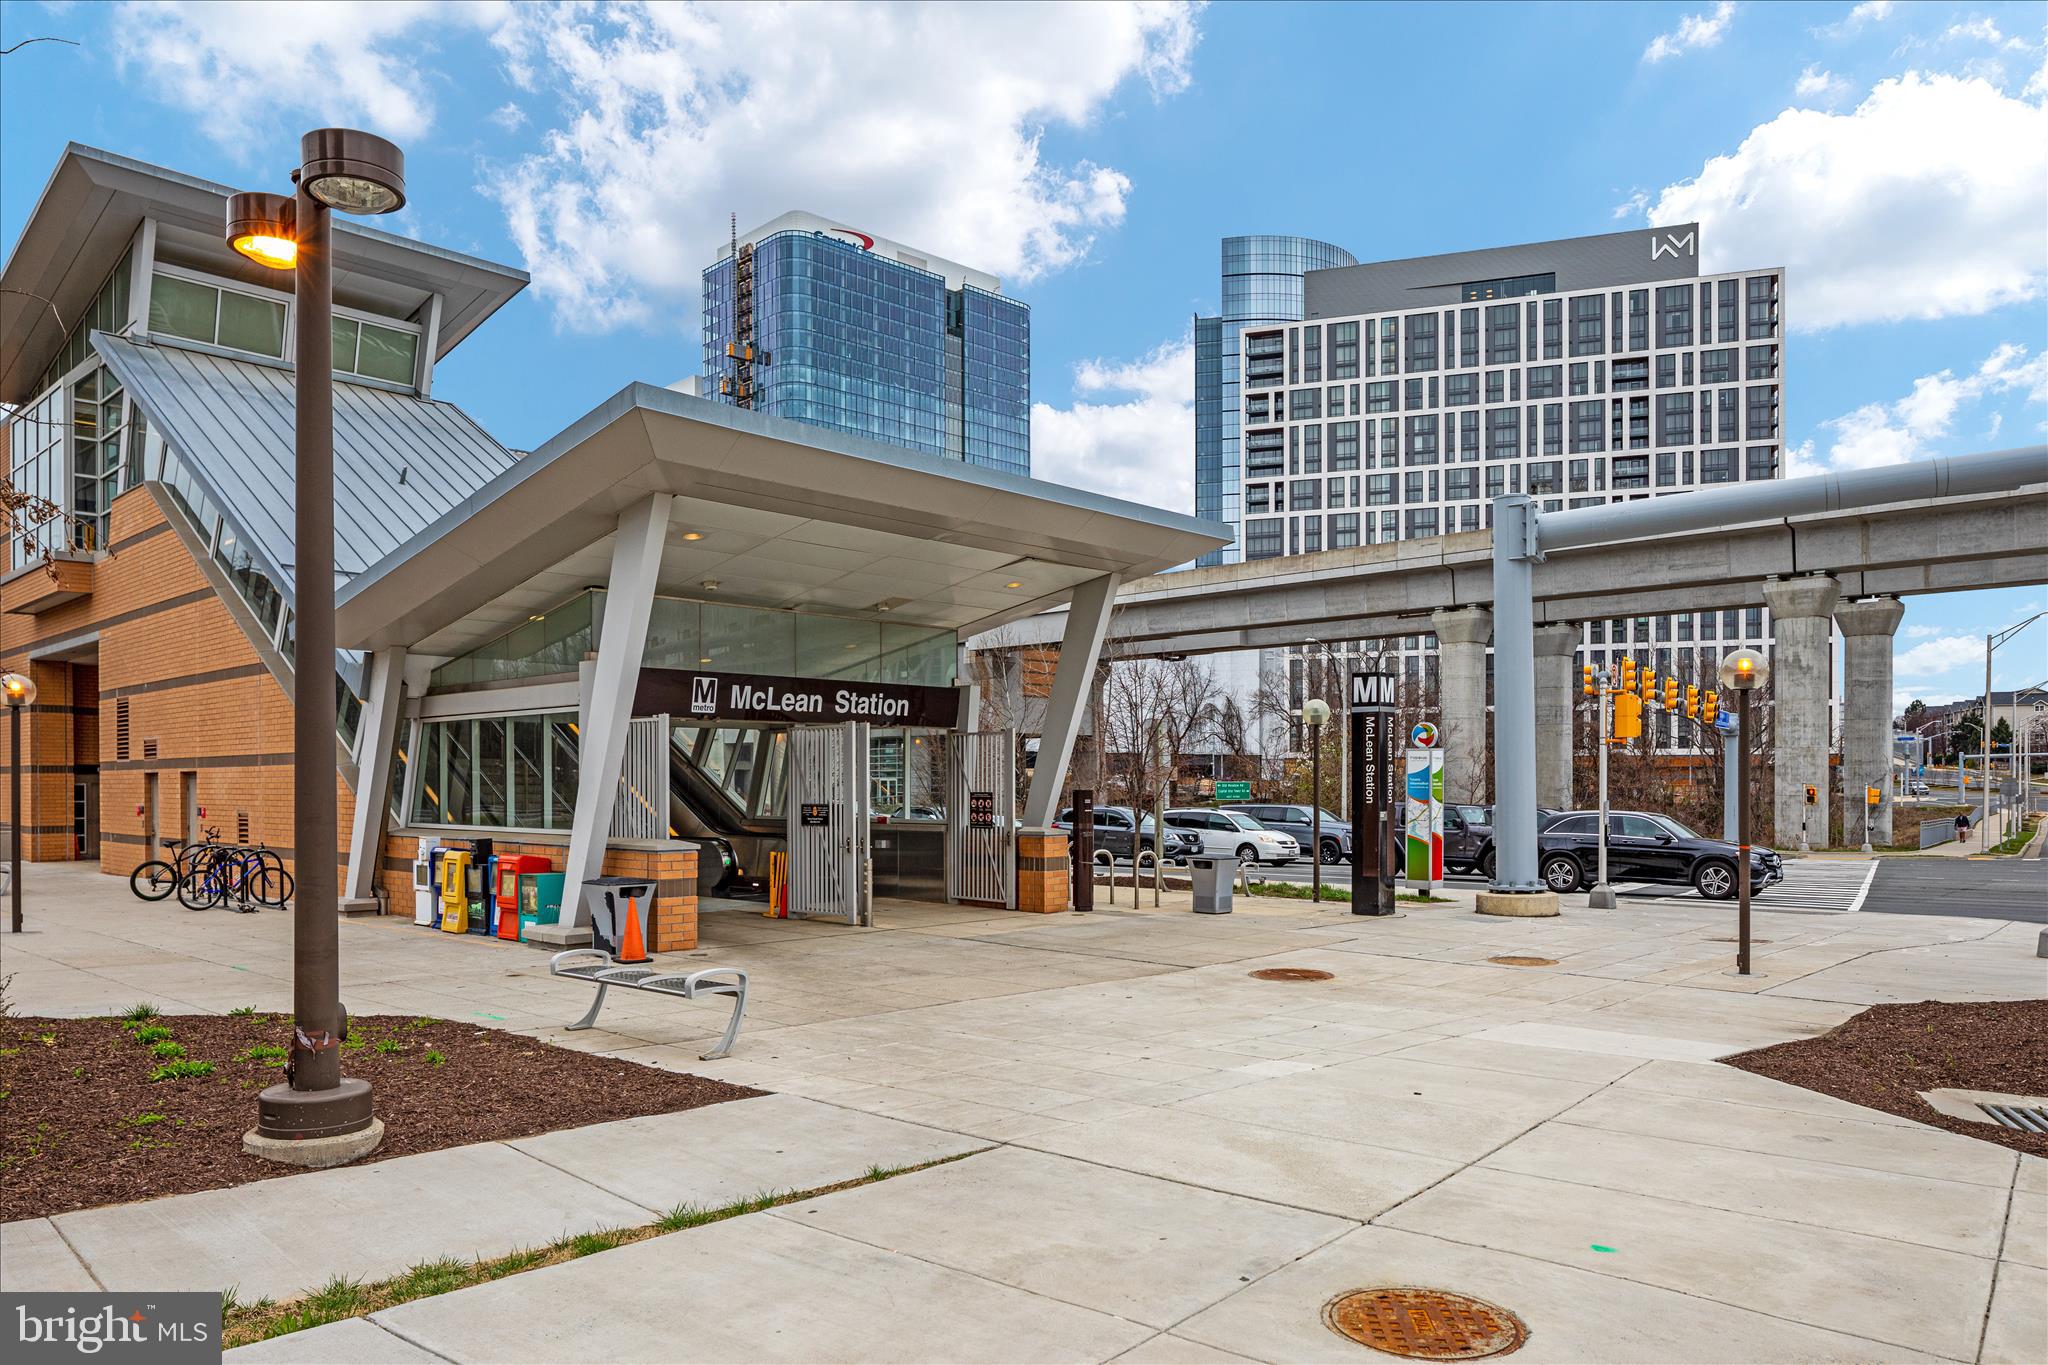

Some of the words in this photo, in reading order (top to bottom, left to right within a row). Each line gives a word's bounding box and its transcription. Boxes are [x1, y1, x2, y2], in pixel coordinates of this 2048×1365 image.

[693, 678, 717, 704] M
[730, 684, 823, 713] McLean
[834, 689, 909, 717] Station
[1353, 676, 1378, 704] M
[1380, 676, 1395, 704] M
[692, 704, 715, 712] metro
[1365, 716, 1376, 761] McLean
[1365, 764, 1376, 804] Station
